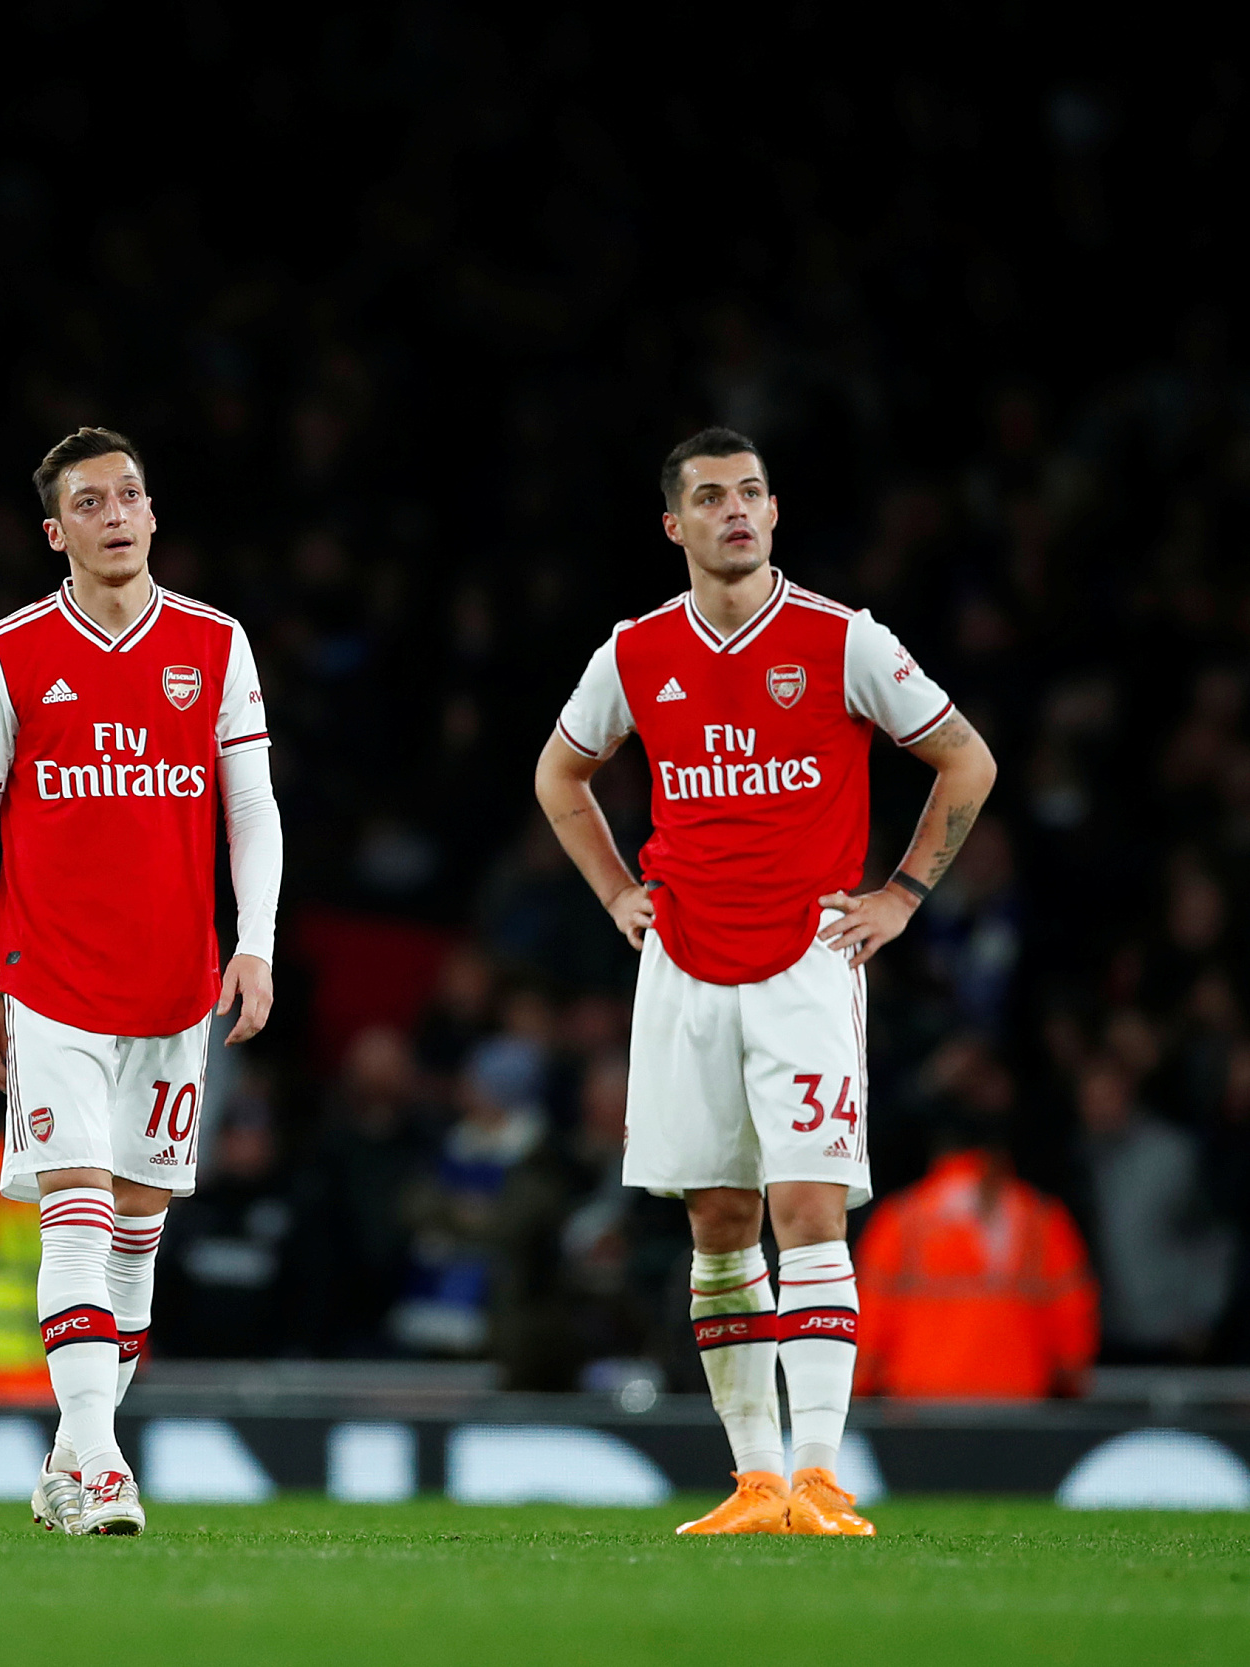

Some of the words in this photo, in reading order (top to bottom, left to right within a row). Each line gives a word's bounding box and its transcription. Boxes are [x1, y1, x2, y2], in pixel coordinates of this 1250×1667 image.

[42, 692, 78, 704] adidas
[656, 691, 687, 702] adidas
[93, 722, 147, 758] Fly
[704, 723, 756, 757] Fly
[35, 754, 205, 800] Emirates
[659, 755, 821, 800] Emirates
[145, 1080, 196, 1141] 10
[792, 1074, 857, 1134] 34
[149, 1157, 178, 1166] adidas
